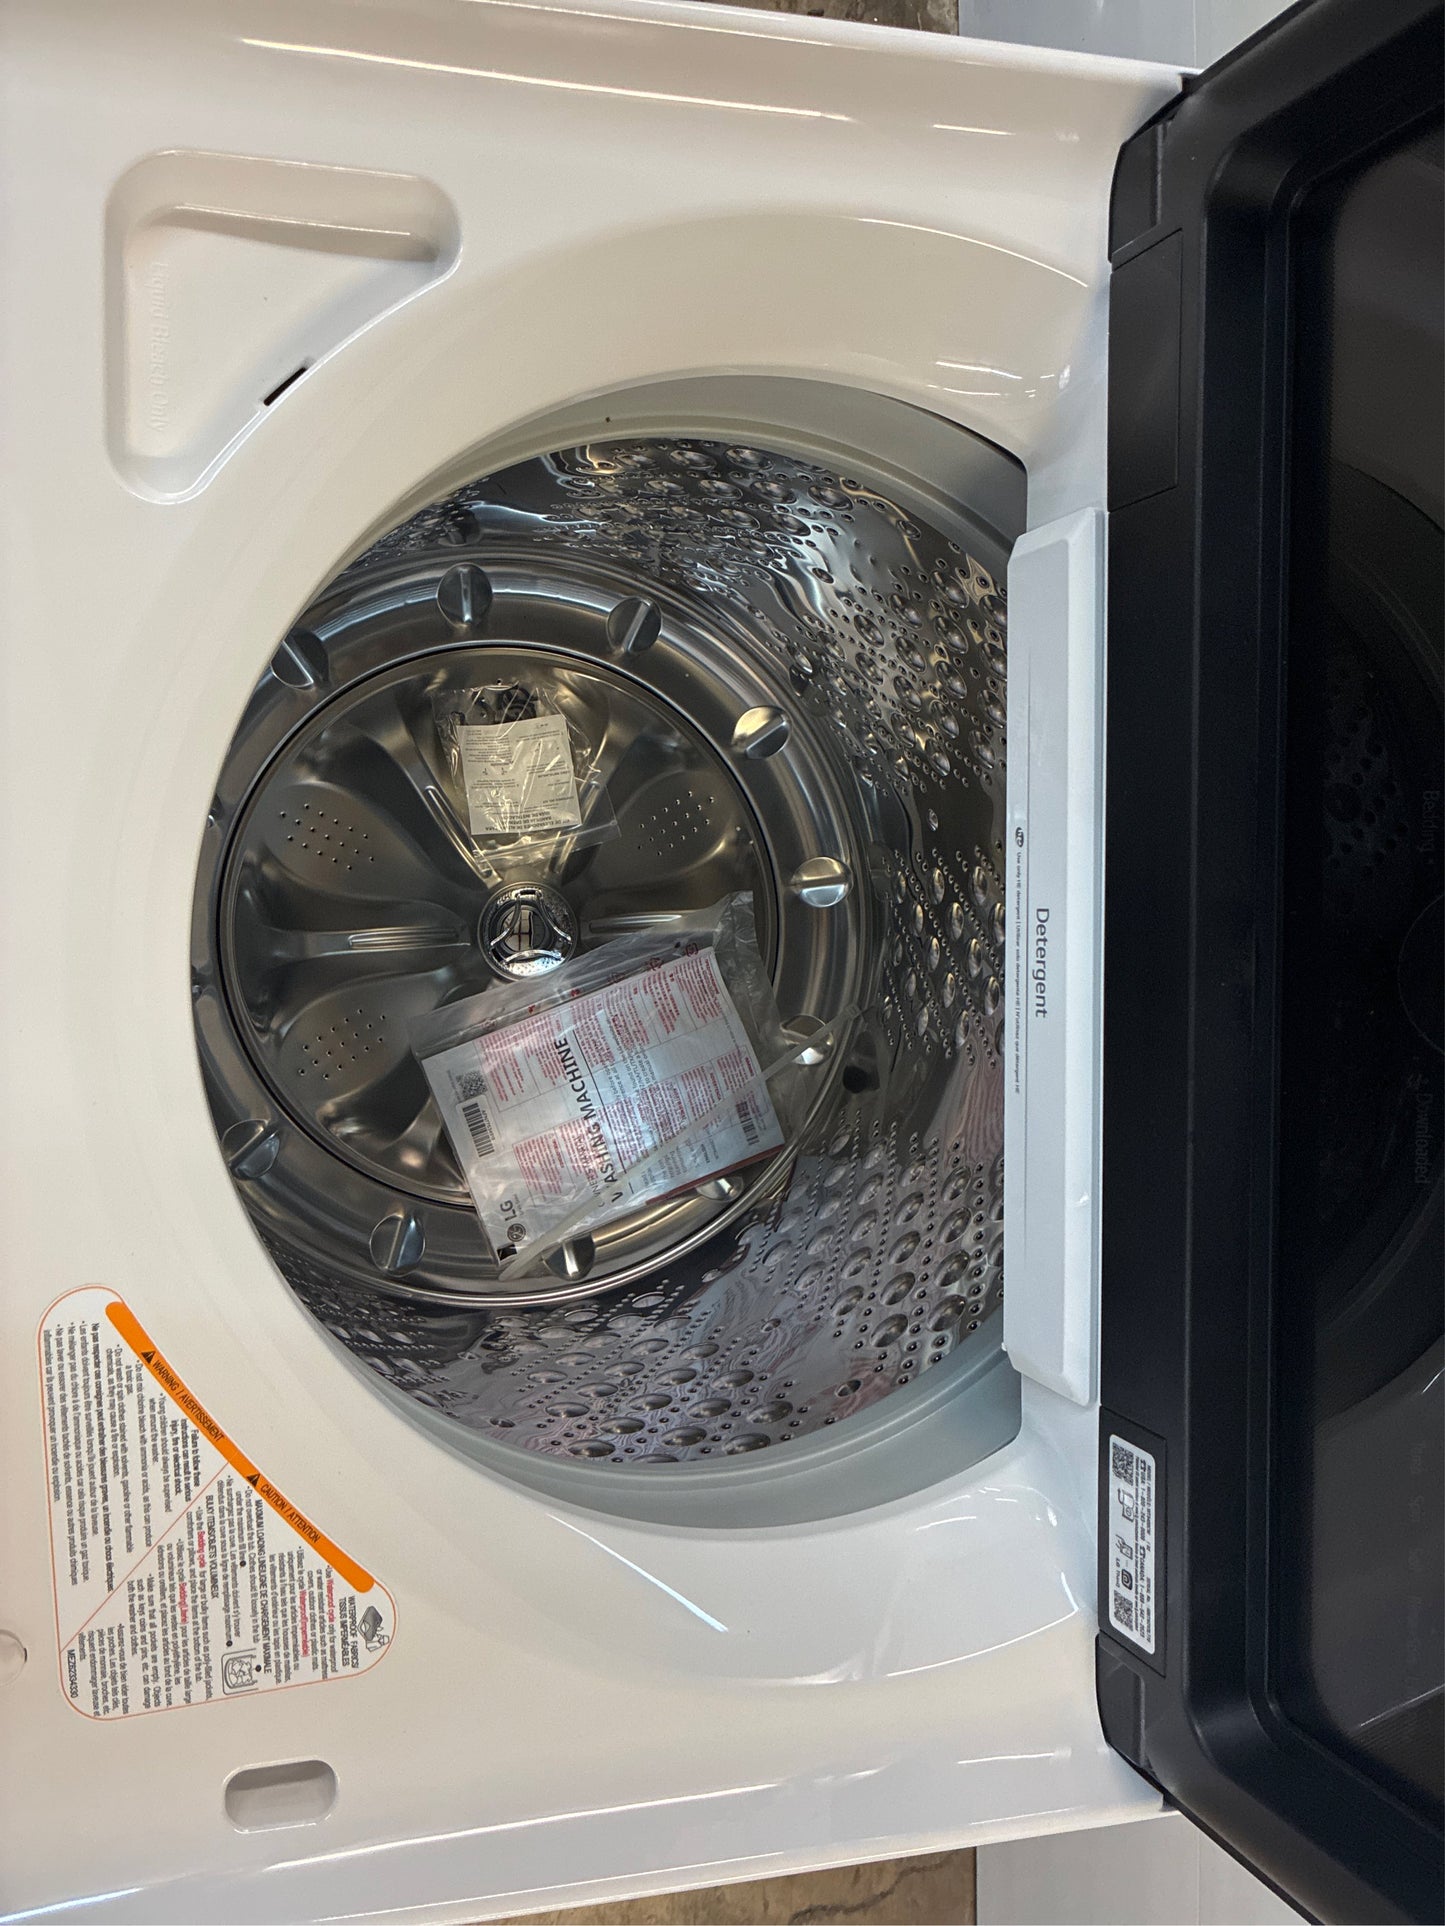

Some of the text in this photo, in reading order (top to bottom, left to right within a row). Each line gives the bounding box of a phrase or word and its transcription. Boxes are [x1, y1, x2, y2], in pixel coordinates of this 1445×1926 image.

[144, 262, 170, 432] Liquid Bleach Only
[1418, 790, 1439, 852] Bedding
[1032, 908, 1050, 1018] Detergent
[554, 1035, 598, 1122] MACHINE
[1414, 1092, 1433, 1184] Downloaded
[499, 1199, 518, 1221] LG
[149, 1397, 157, 1412] when
[152, 1360, 180, 1392] WARNING
[178, 1394, 224, 1442] AVERTISSEMENT
[158, 1397, 167, 1414] Young
[150, 1413, 158, 1432] around
[160, 1415, 168, 1436] children
[151, 1433, 159, 1442] the
[172, 1437, 180, 1445] fire
[181, 1418, 190, 1448] instructions
[191, 1429, 200, 1448] Failure
[161, 1437, 170, 1454] should
[161, 1456, 171, 1474] always
[173, 1453, 182, 1477] electrical
[183, 1460, 191, 1475] result
[192, 1455, 201, 1470] follow
[193, 1472, 202, 1487] these
[162, 1483, 173, 1512] supervised
[185, 1482, 193, 1502] serious
[236, 1490, 244, 1506] under
[206, 1495, 215, 1514] BULKY
[237, 1507, 245, 1516] the
[255, 1499, 264, 1528] MAXIMUM
[260, 1484, 288, 1511] CAUTION
[286, 1512, 320, 1544] ATTENTION
[246, 1508, 255, 1531] overload
[237, 1517, 246, 1542] maximum
[257, 1529, 266, 1555] LOADING
[239, 1550, 247, 1560] line
[249, 1552, 257, 1572] Clothes
[210, 1560, 219, 1599] VOLUMINEUX
[326, 1567, 334, 1578] Use
[128, 1580, 136, 1592] both
[137, 1578, 146, 1592] such
[147, 1576, 156, 1592] Make
[250, 1574, 258, 1591] should
[309, 1590, 317, 1610] outdoor
[325, 1579, 335, 1608] Waterproof
[129, 1603, 137, 1622] washer
[137, 1602, 147, 1616] keys
[149, 1608, 157, 1619] that
[250, 1598, 259, 1617] loosely
[327, 1608, 336, 1622] cycle
[348, 1595, 358, 1637] WATERPROOF
[130, 1624, 138, 1634] and
[140, 1617, 148, 1632] coins
[260, 1599, 271, 1640] CHARGEMENT
[310, 1611, 318, 1630] clothes
[319, 1614, 327, 1633] articles
[328, 1624, 337, 1634] only
[141, 1634, 149, 1645] and
[253, 1634, 261, 1643] tub
[339, 1596, 351, 1666] TISSUS IMPERMÉABLES
[149, 1630, 159, 1652] pockets
[310, 1638, 319, 1655] plastic
[263, 1642, 272, 1674] MAXIMALE
[329, 1644, 339, 1672] waterproof
[321, 1656, 329, 1680] mattress
[142, 1686, 152, 1708] damage
[152, 1686, 162, 1707] Objects
